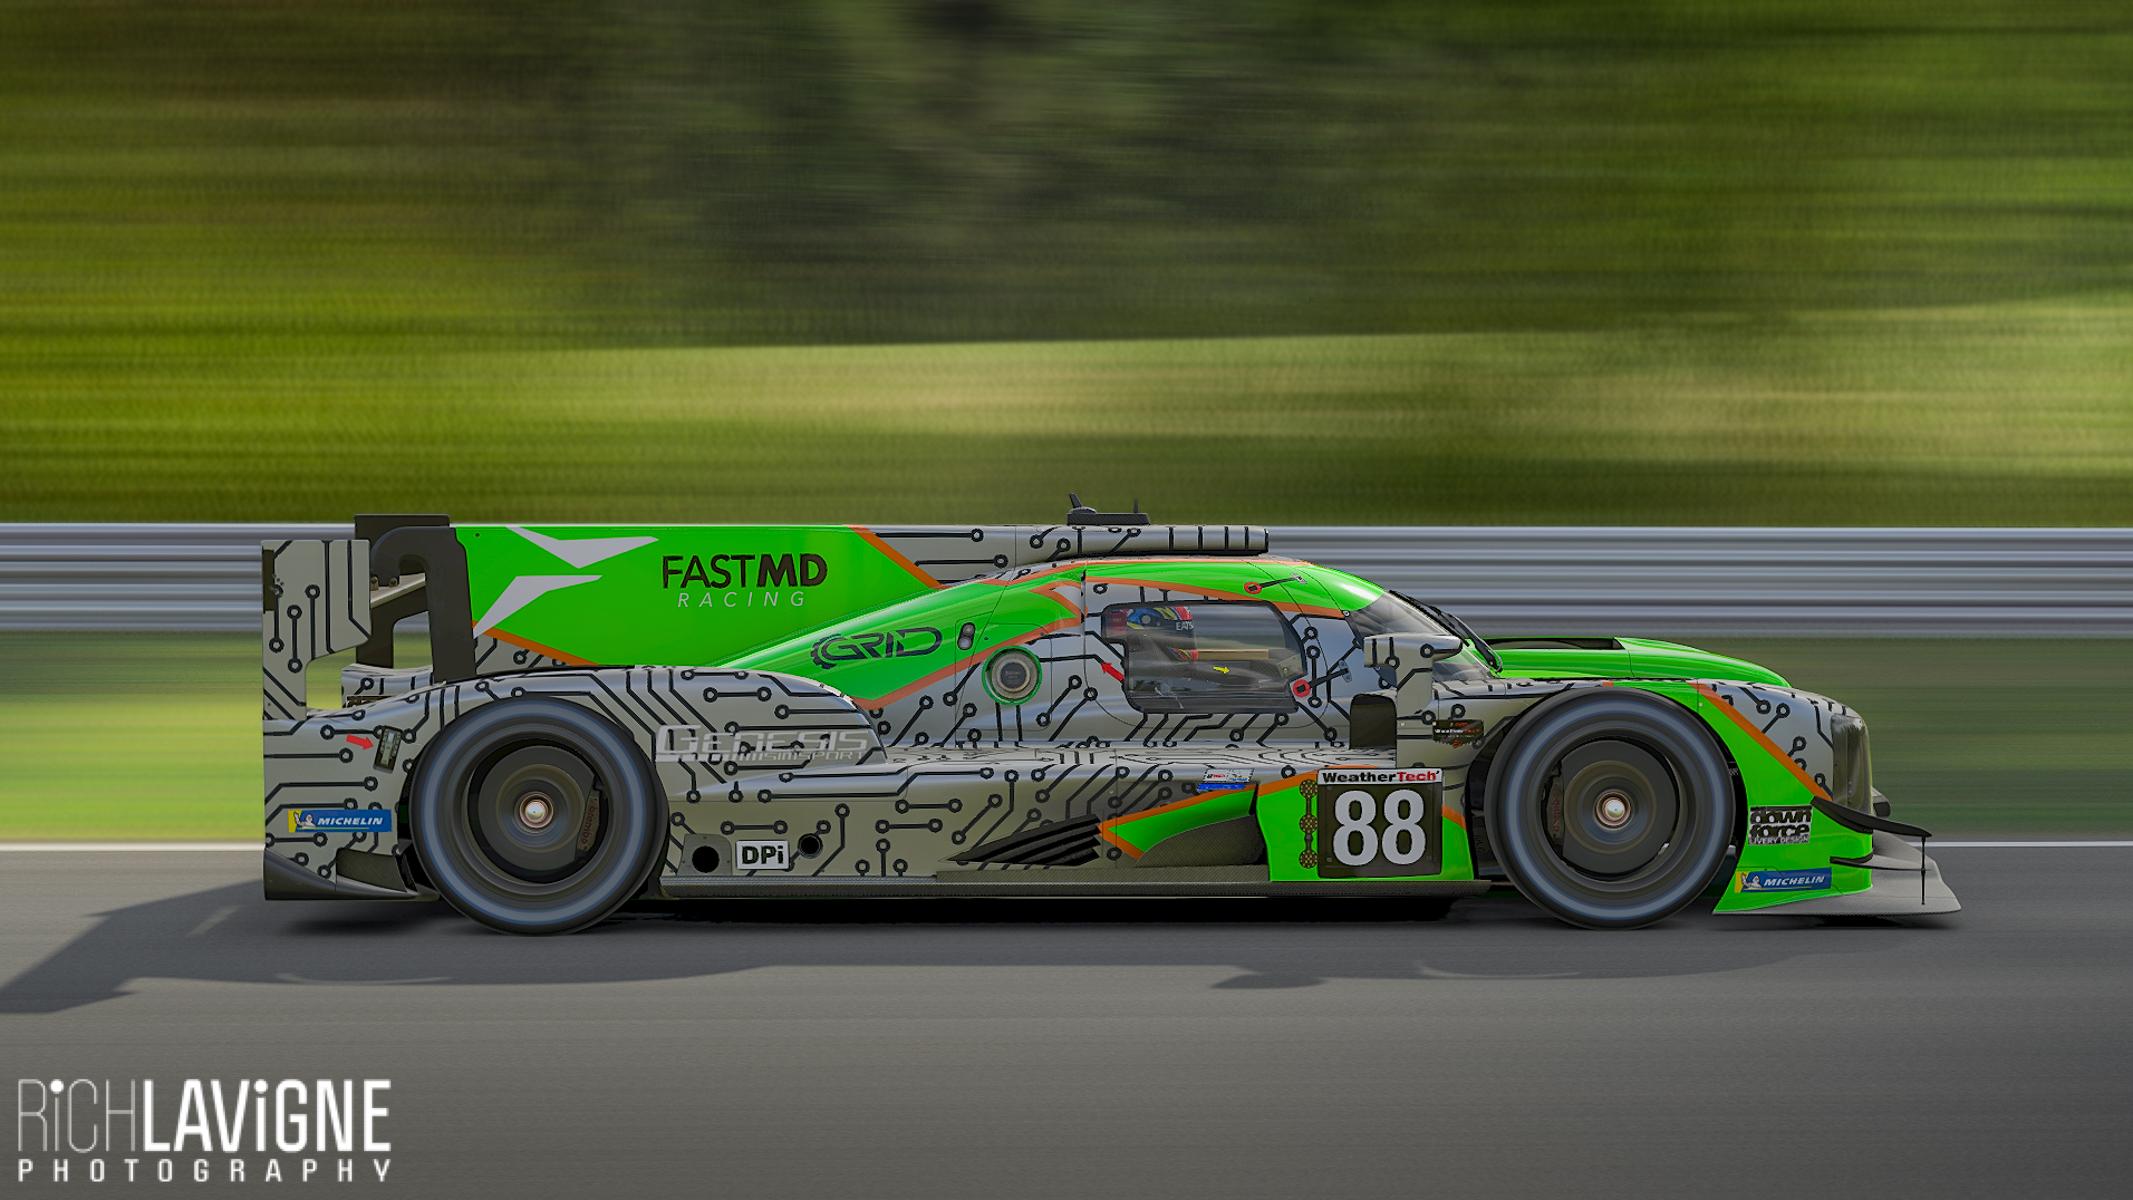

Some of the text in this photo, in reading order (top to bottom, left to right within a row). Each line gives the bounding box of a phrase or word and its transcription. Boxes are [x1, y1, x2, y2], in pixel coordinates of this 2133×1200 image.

[677, 591, 805, 608] RACING
[818, 627, 943, 662] GRID
[1322, 771, 1438, 782] WeatherTech
[317, 817, 384, 826] MICHELIN
[1750, 808, 1811, 824] down
[1333, 789, 1426, 866] 88
[1749, 824, 1810, 838] force
[741, 845, 784, 864] DPi
[1764, 875, 1825, 886] MICHELIN
